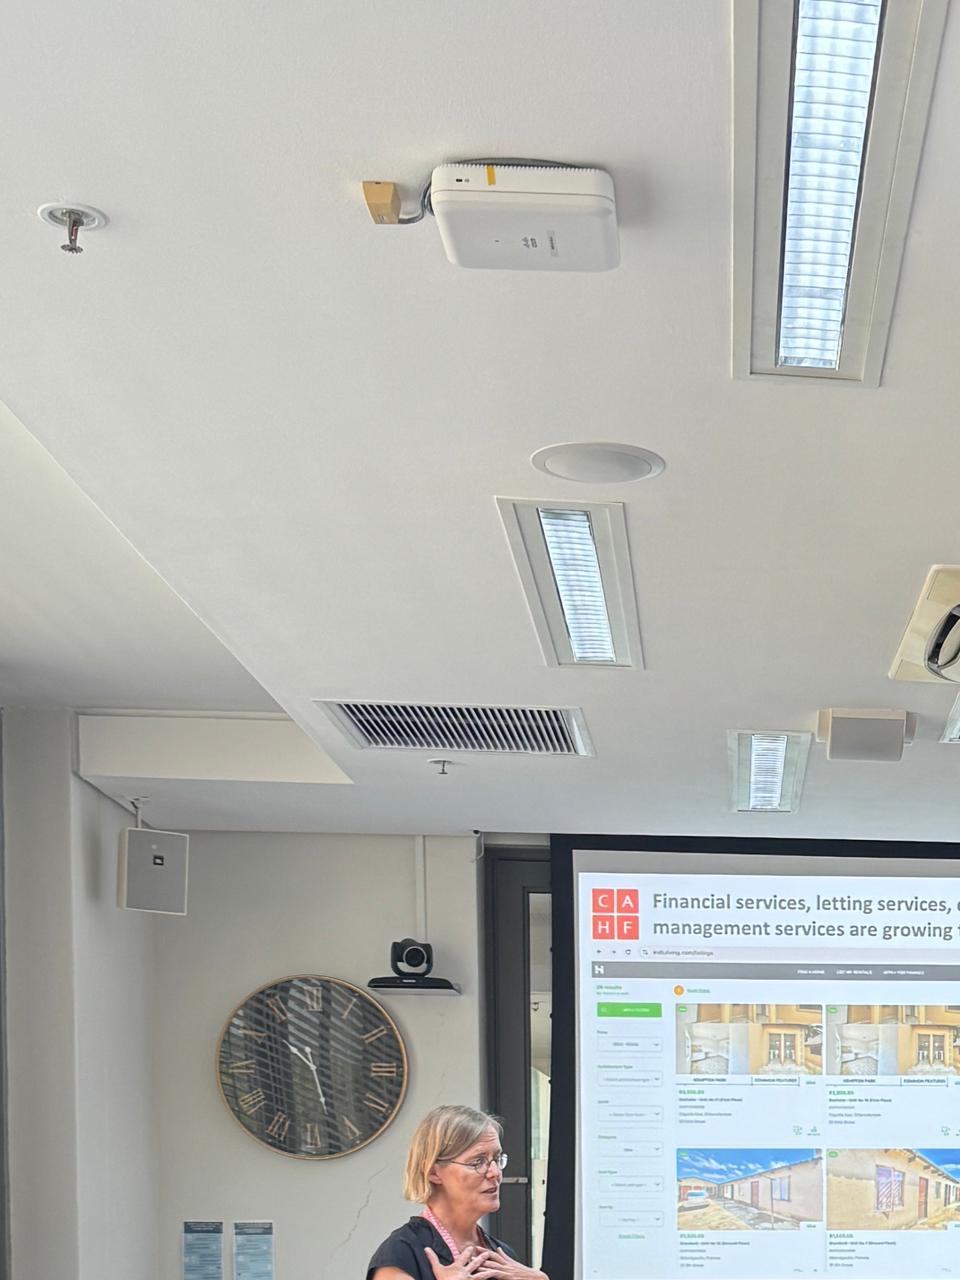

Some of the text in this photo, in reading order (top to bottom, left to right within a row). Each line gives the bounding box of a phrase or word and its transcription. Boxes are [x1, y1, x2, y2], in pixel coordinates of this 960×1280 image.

[653, 893, 731, 910] Financial
[736, 895, 811, 913] services,
[816, 895, 872, 914] letting
[878, 896, 951, 915] services,
[653, 921, 770, 938] management
[775, 920, 845, 936] services
[849, 924, 877, 936] are
[882, 922, 953, 941] growing
